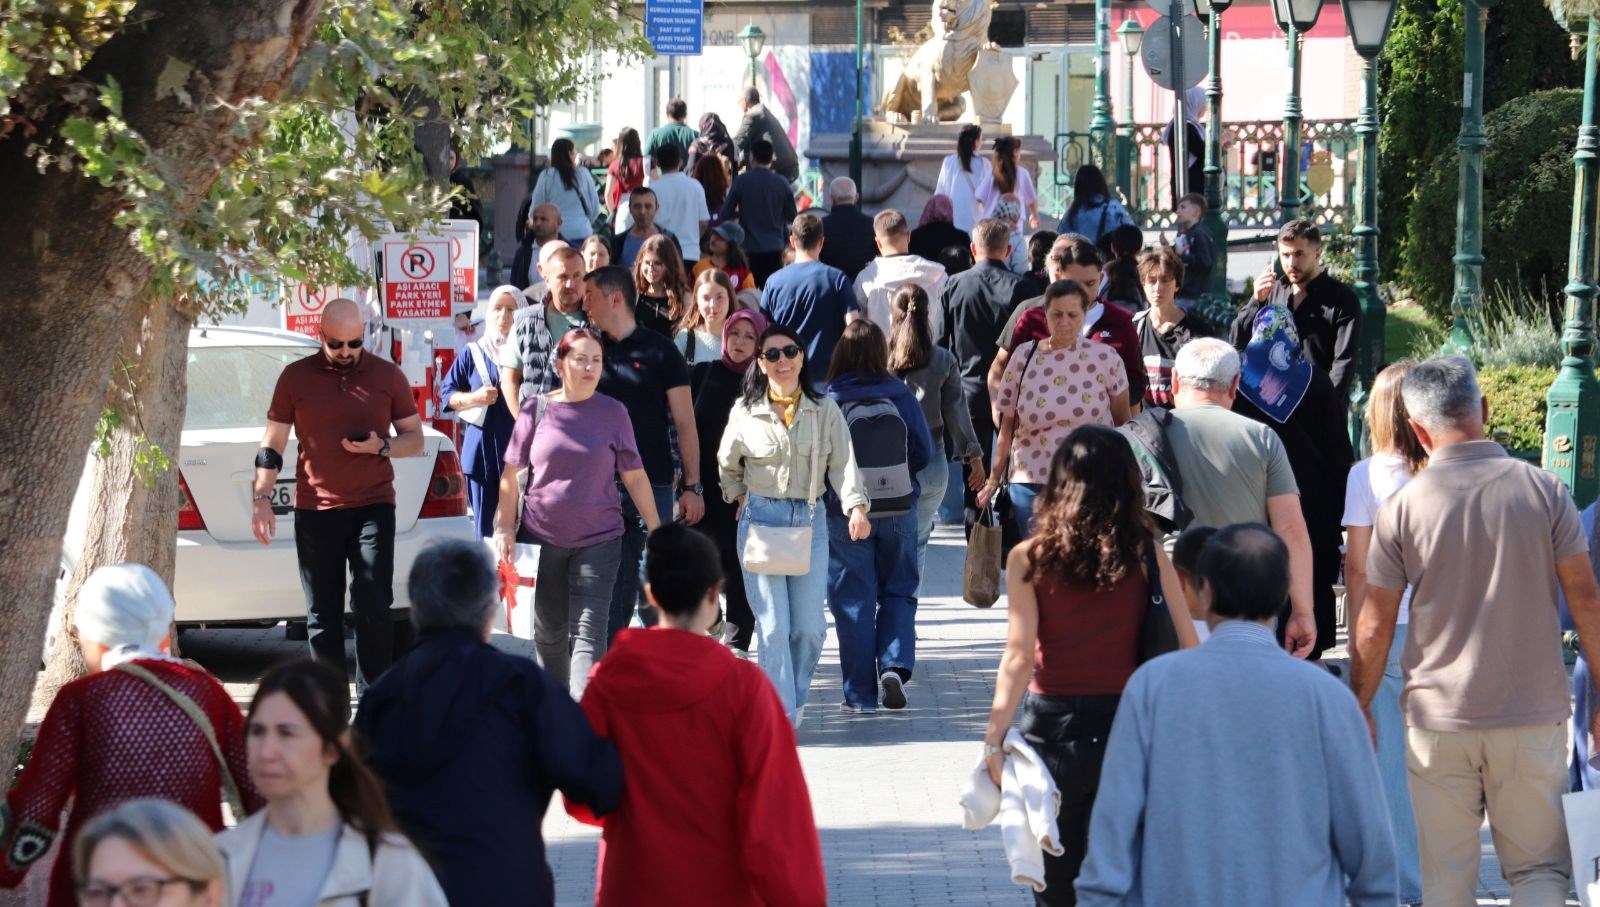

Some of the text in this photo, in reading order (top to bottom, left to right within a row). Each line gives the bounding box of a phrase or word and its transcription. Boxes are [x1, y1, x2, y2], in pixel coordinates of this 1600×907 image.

[711, 30, 735, 46] QNB
[397, 283, 440, 291] AŞI ARACI
[395, 289, 441, 300] PARK YERİ
[390, 300, 447, 309] PARK ETMEK
[397, 309, 440, 317] YASAKTIR
[271, 486, 290, 505] 26
